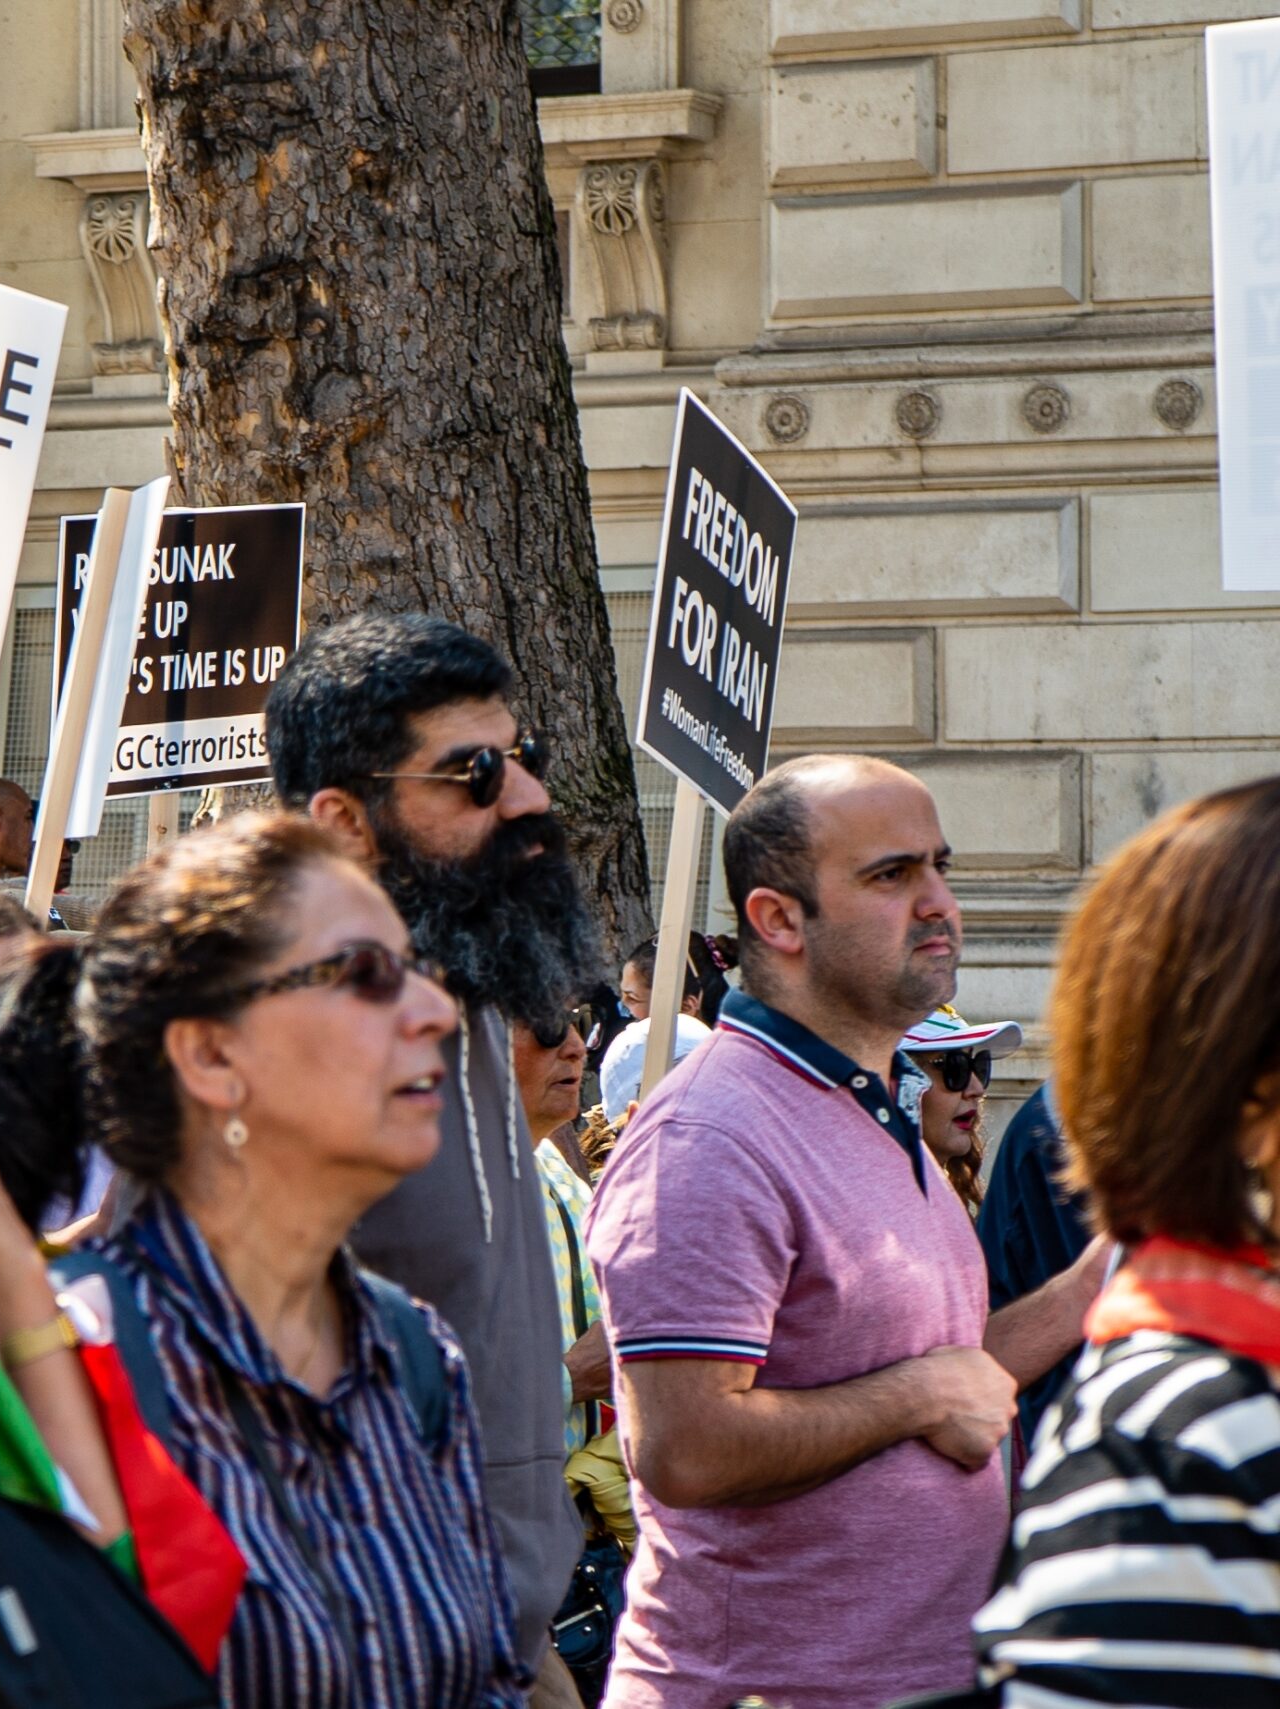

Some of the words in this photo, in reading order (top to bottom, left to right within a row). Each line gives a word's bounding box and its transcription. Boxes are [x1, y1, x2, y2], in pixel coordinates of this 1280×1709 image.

[149, 543, 237, 585] SUNAK
[681, 465, 780, 627] FREEDOM
[154, 600, 189, 639] UP
[160, 651, 218, 692] TIME
[224, 648, 247, 687] IS
[253, 645, 286, 684] UP
[666, 575, 718, 683] FOR
[717, 621, 769, 733] IRAN
[110, 725, 268, 773] GCterrorists
[661, 687, 755, 791] #WomanLifeFreedom
